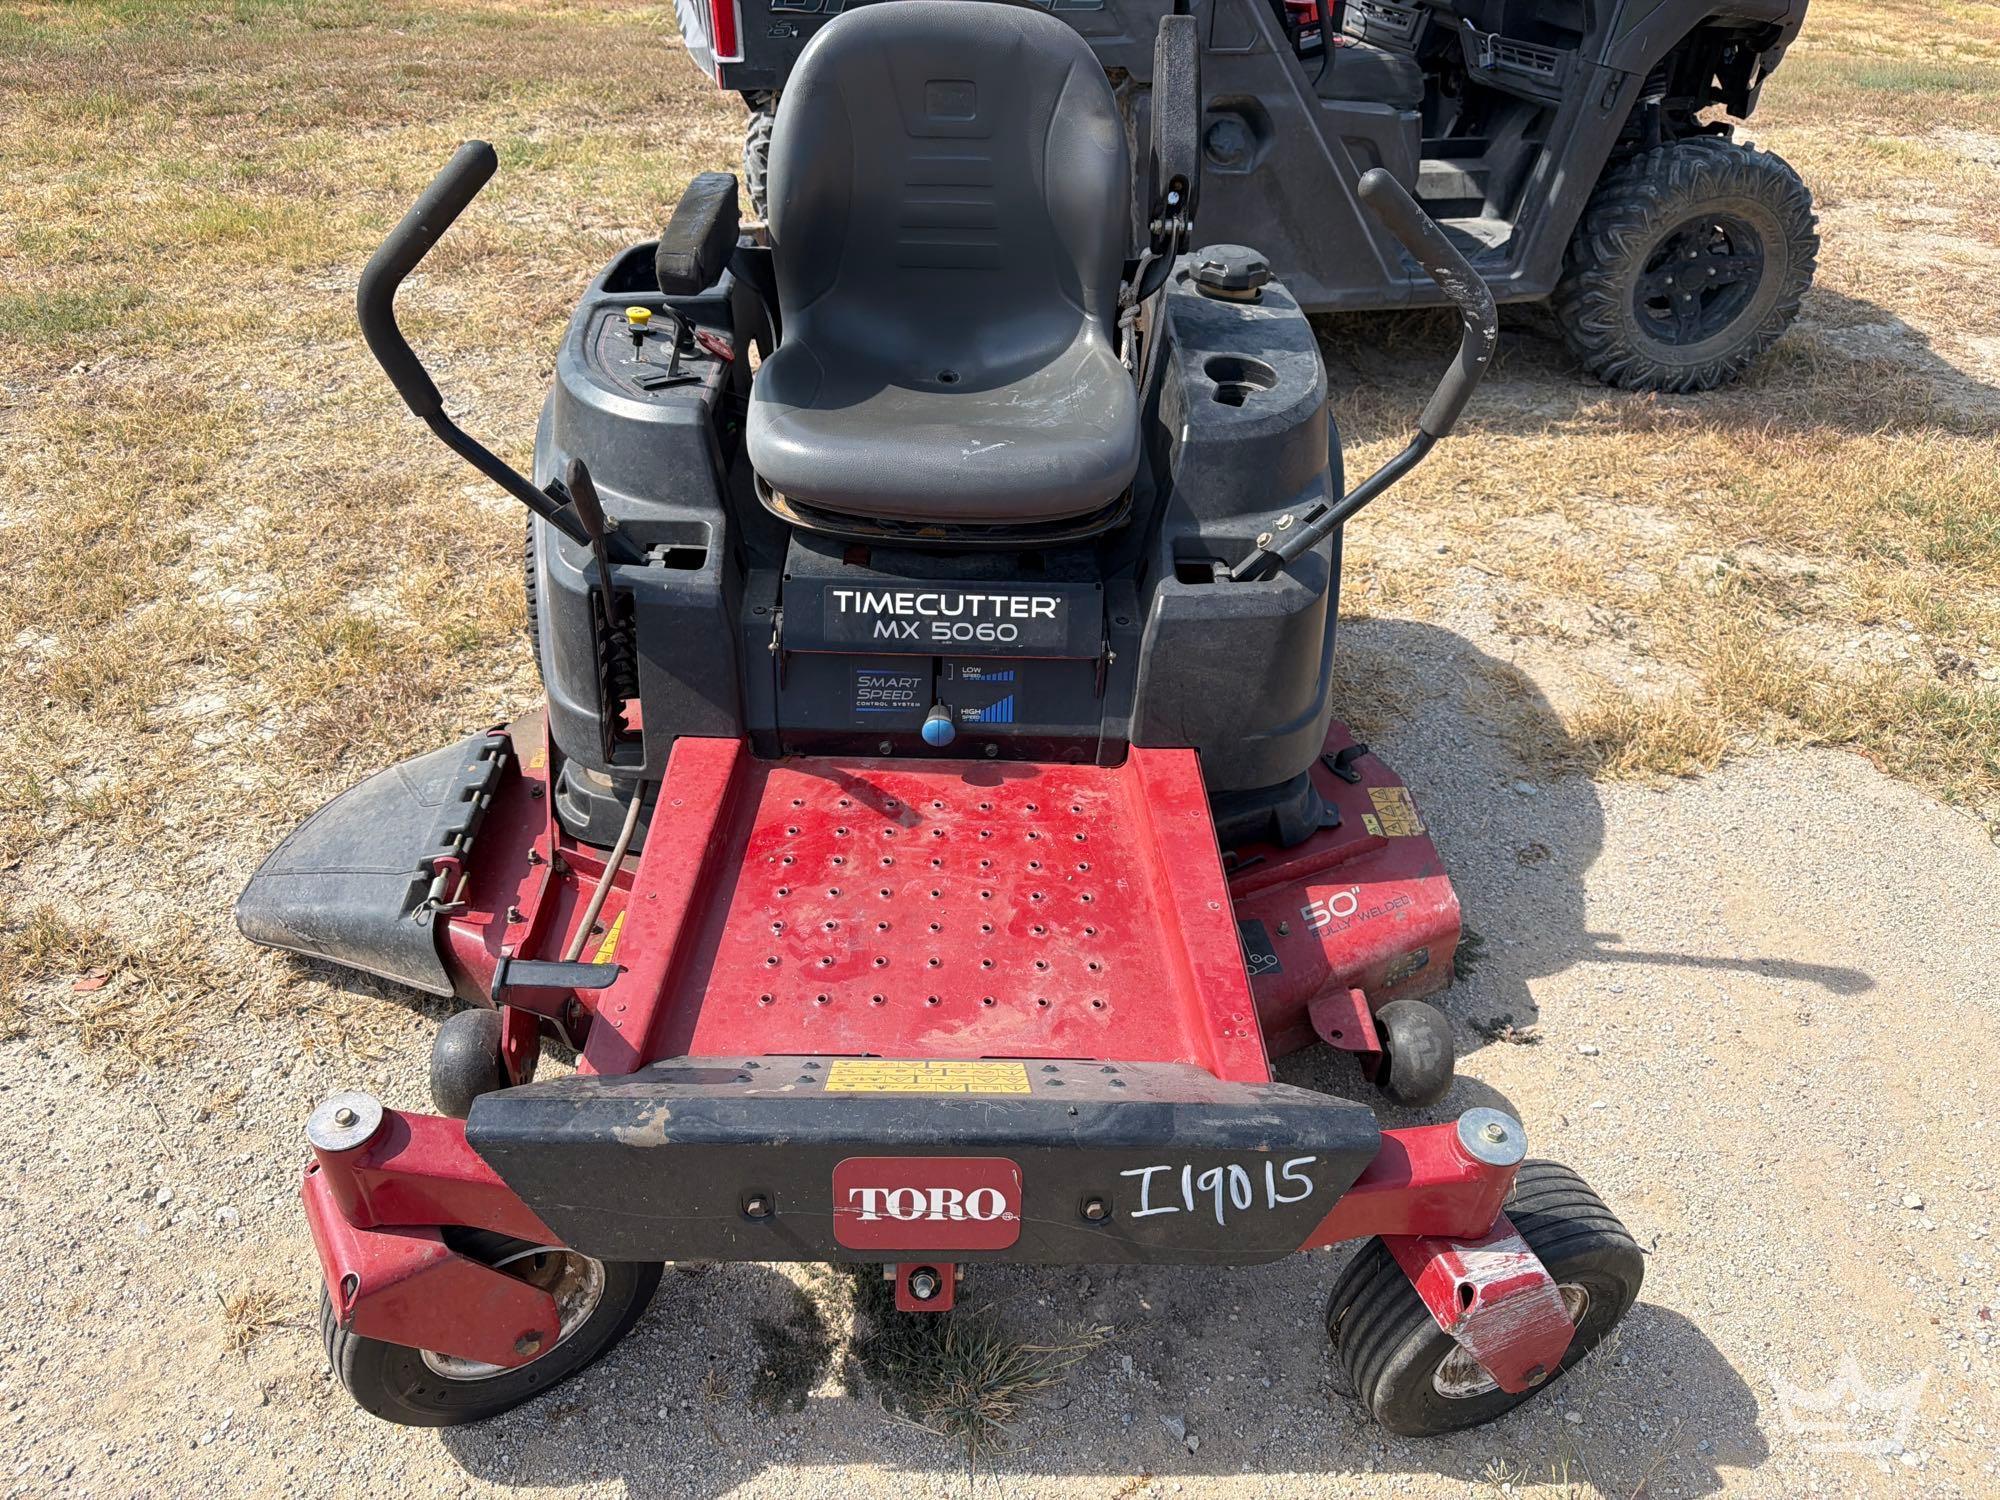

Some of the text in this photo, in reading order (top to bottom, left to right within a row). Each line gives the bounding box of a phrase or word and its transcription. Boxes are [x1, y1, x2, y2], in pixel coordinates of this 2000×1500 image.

[873, 620, 1018, 642] MX 5060
[857, 676, 922, 688] SMART
[857, 688, 914, 700] SPEED
[1311, 895, 1411, 939] FULLY WELDED
[849, 1187, 1007, 1221] TORO
